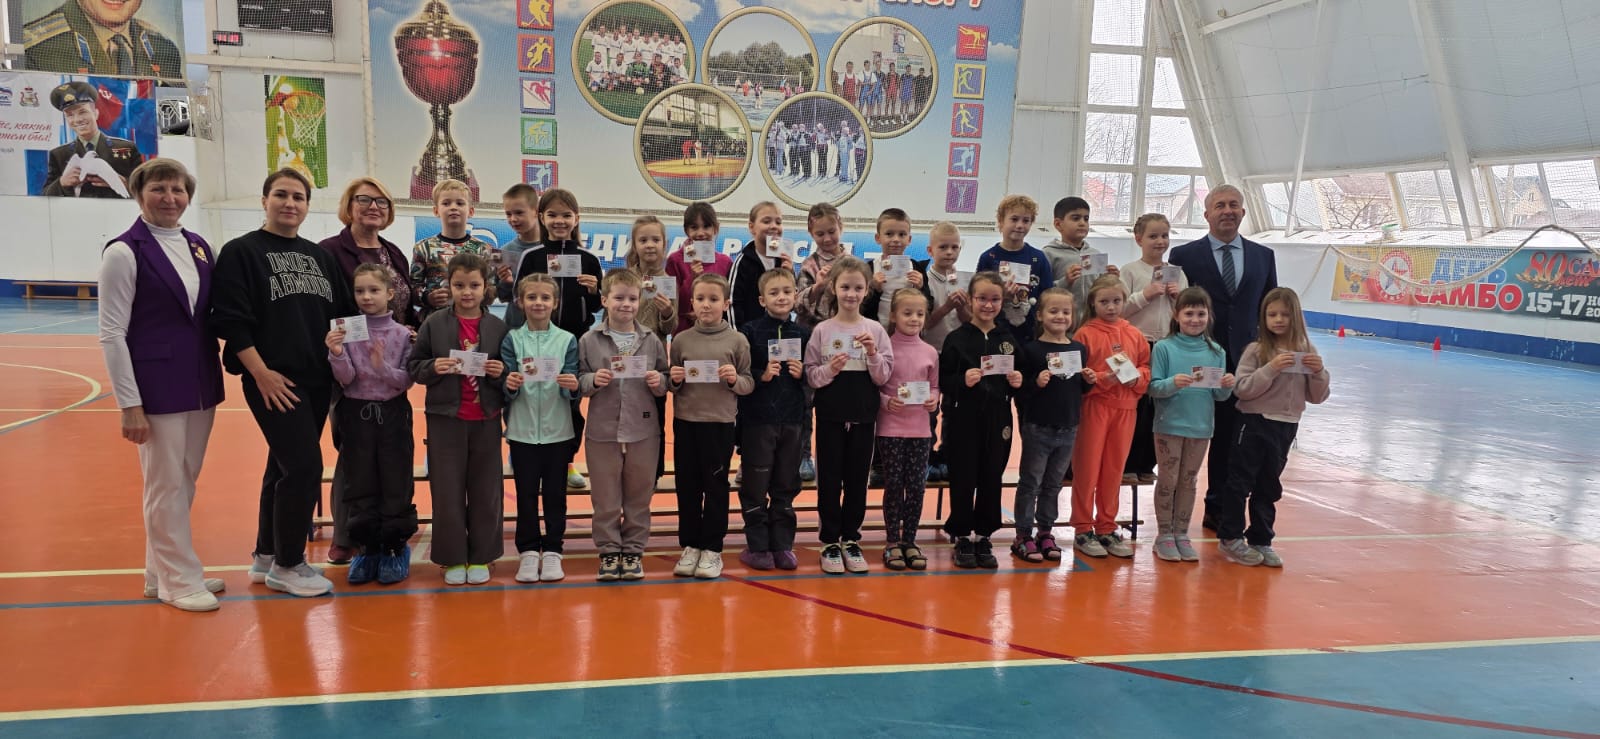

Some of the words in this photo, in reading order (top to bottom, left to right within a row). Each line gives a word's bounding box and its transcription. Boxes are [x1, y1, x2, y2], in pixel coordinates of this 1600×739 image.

[266, 252, 324, 277] UNDER
[1430, 257, 1506, 284] ДЕНЬ
[1526, 251, 1568, 281] 80
[1414, 279, 1523, 312] САМБО
[1526, 291, 1587, 316] 15-17
